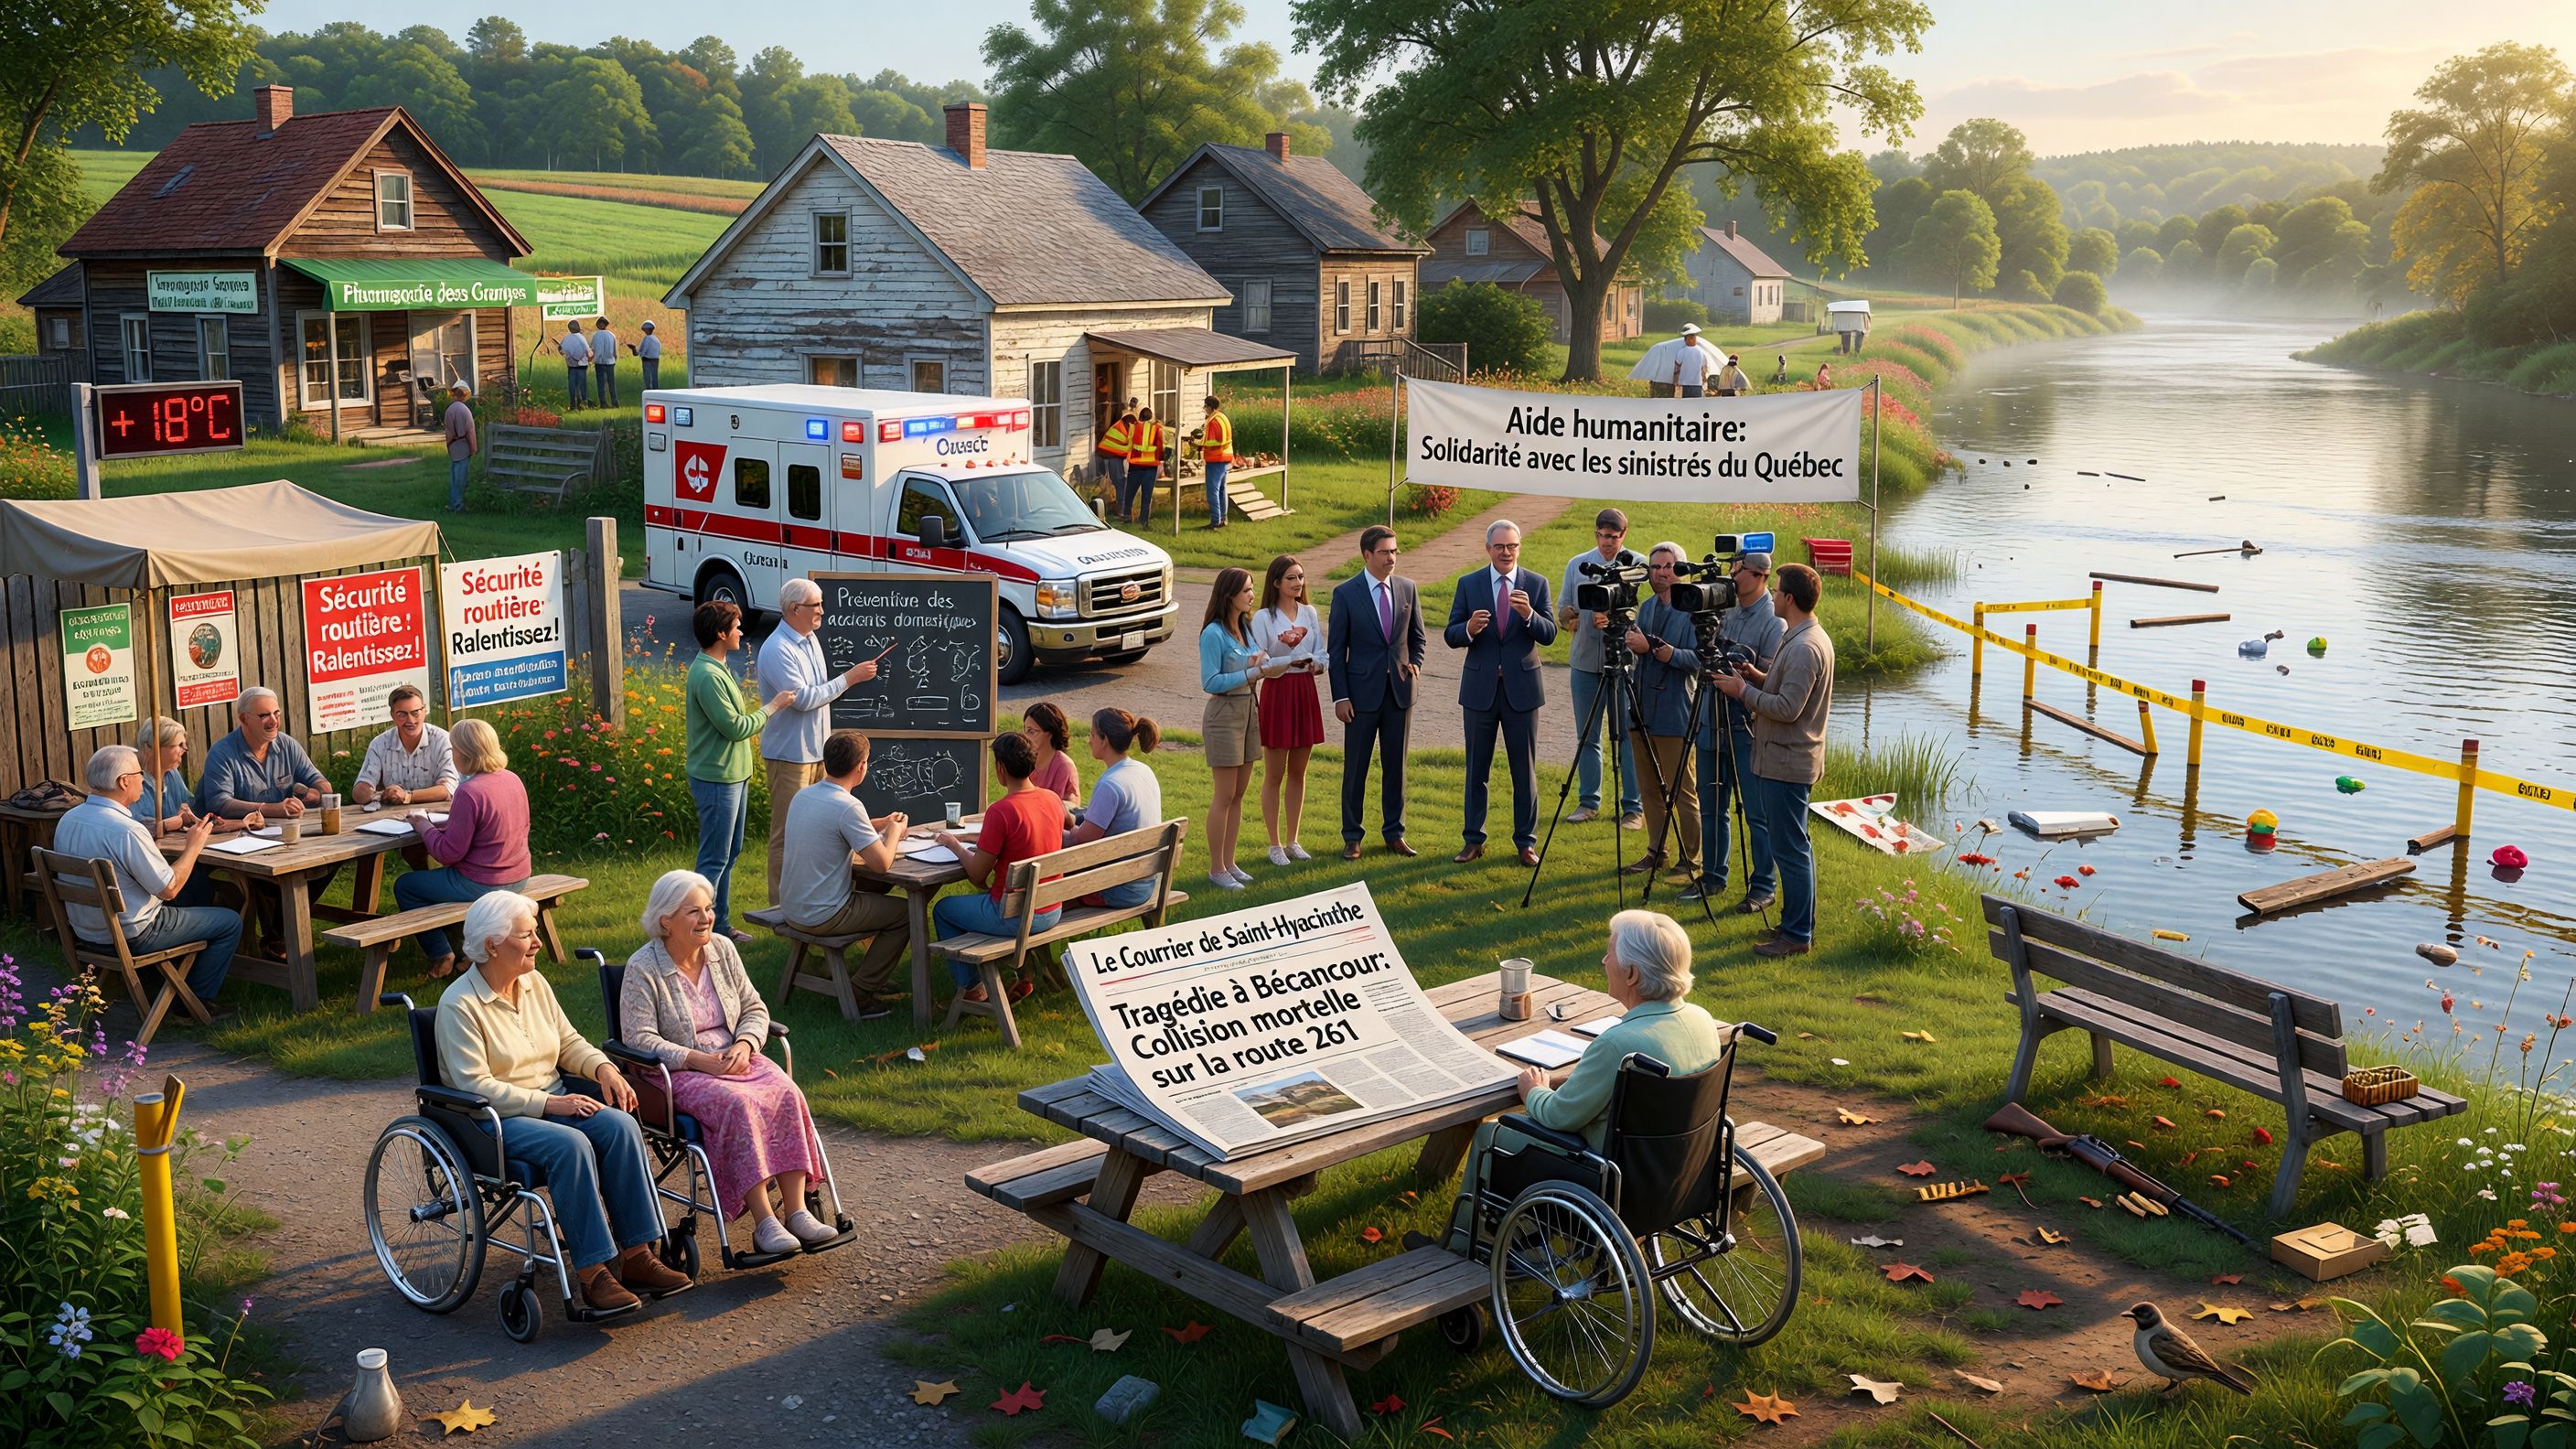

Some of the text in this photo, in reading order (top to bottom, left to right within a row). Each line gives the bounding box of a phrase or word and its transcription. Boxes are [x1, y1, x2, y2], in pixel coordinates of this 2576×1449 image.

[1505, 406, 1746, 443] Aide humanitaire:
[1421, 435, 1843, 483] Solidarité avec les sinistrés du Québec
[319, 574, 407, 613] Sécurité
[461, 561, 543, 596] Sécurité
[927, 590, 955, 609] des
[312, 634, 421, 674] Ralentissez!
[452, 617, 559, 655] Ralentissez!
[1090, 951, 1117, 975] Le
[1119, 938, 1195, 970] Courrier
[1199, 930, 1223, 954] de
[1222, 900, 1365, 950] Saint-Hyacinthe
[1110, 983, 1228, 1031] Tragédie
[1229, 979, 1250, 1004] à
[1250, 951, 1391, 1000] Bécancour:
[1131, 1013, 1249, 1060] Collision
[1250, 988, 1362, 1033] mortelle
[1152, 1057, 1197, 1089] sur
[1197, 1052, 1231, 1077] la
[1234, 1036, 1307, 1068] route
[1306, 1018, 1360, 1051] 261
